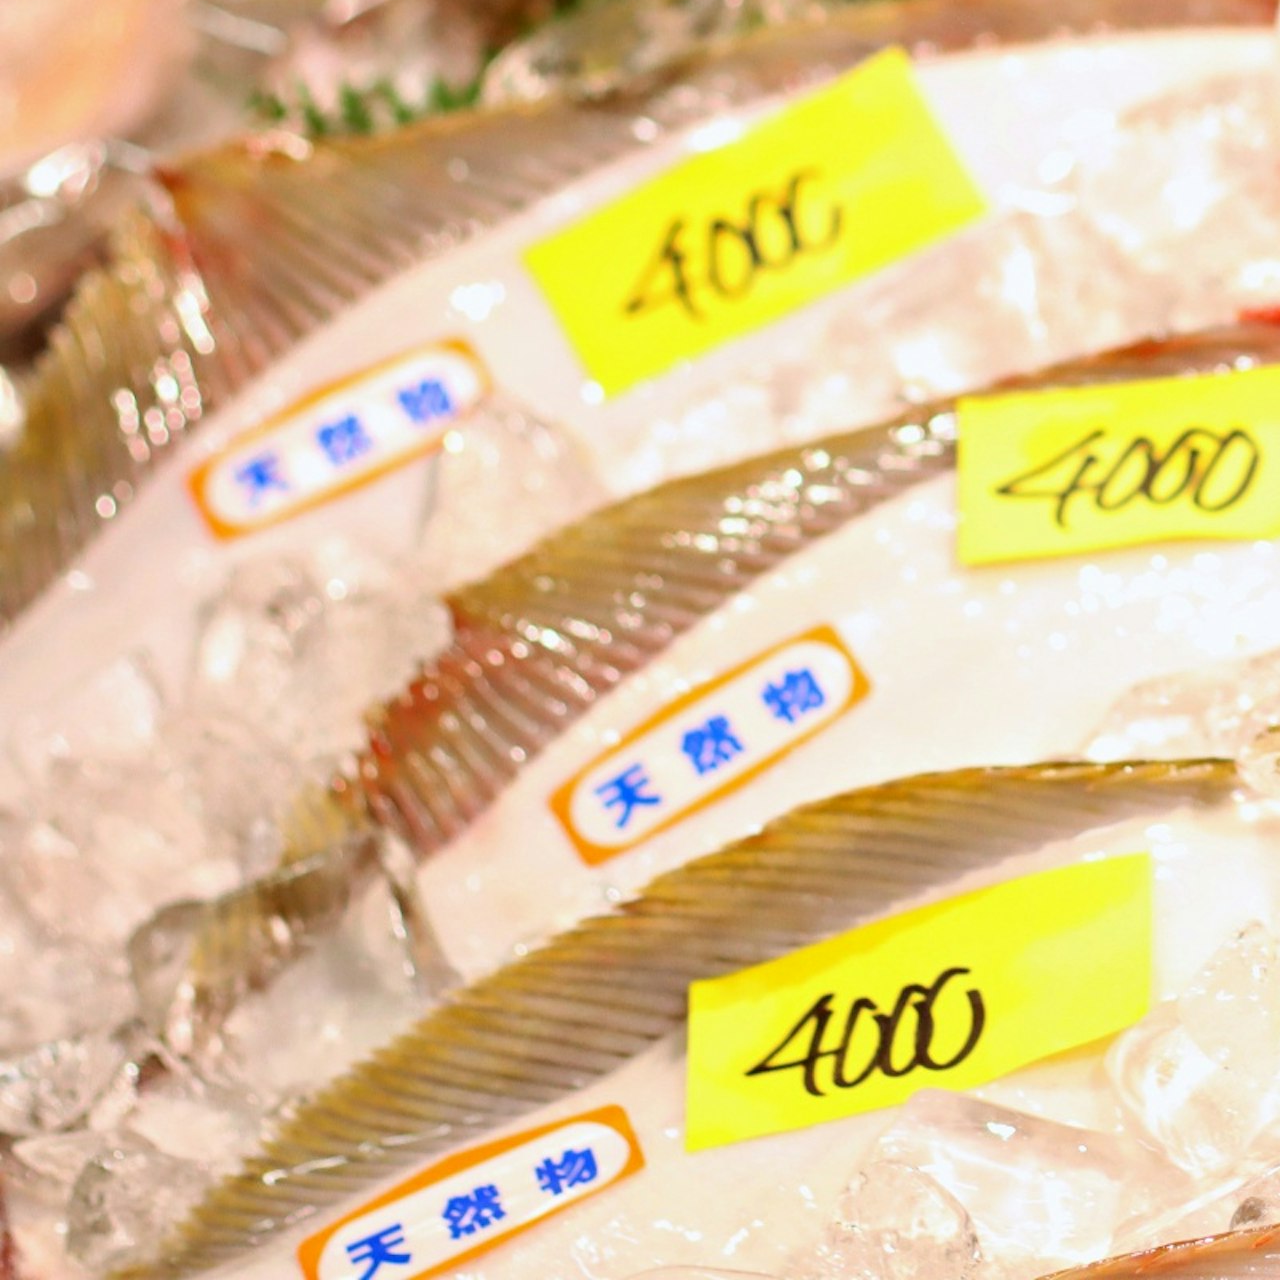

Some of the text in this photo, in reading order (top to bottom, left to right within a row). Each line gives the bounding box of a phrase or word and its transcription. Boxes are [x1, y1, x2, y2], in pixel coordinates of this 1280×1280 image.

[622, 166, 844, 325] 4000
[234, 379, 452, 507] 天然物
[996, 426, 1260, 527] 4000
[593, 666, 826, 829] 天然物
[744, 967, 986, 1097] 4000
[345, 1147, 599, 1280] 天然物
